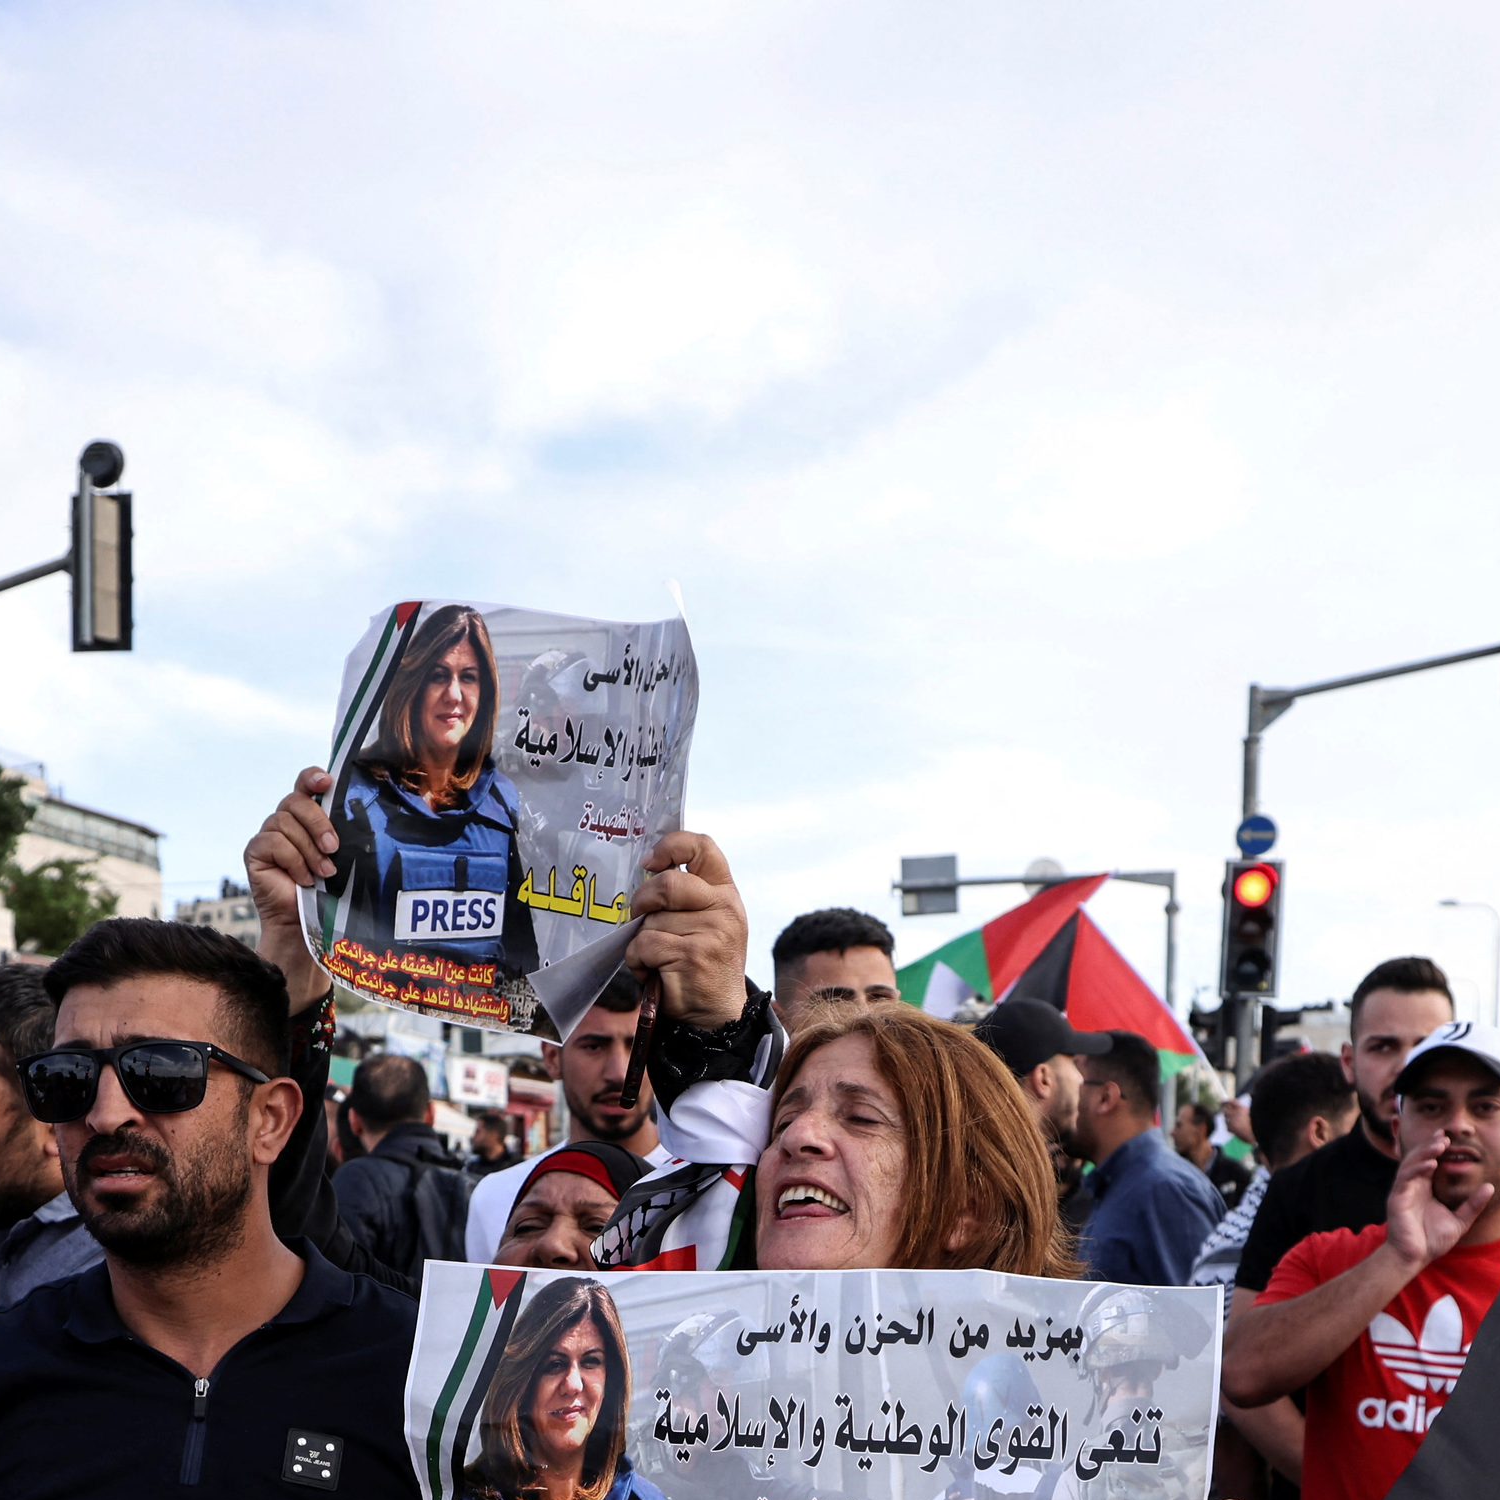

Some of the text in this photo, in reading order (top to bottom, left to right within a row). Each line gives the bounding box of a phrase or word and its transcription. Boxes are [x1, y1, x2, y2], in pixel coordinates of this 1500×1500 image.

[582, 642, 645, 694] والأسى
[513, 706, 635, 783] والإسلامية
[410, 897, 497, 933] PRESS
[333, 941, 378, 968] جرائمكم
[378, 953, 398, 970] على
[353, 971, 398, 998] جرائمكم
[445, 963, 465, 984] عين
[468, 967, 493, 985] كانت
[401, 985, 420, 1001] على
[422, 989, 450, 1007] شاهد
[452, 992, 509, 1021] واستشهادها
[735, 1293, 1085, 1363] بمزيد من الحزن والأسى
[653, 1388, 1164, 1481] تنعى القوى الوطنية والإسلامية
[295, 1455, 312, 1464] ROYAL
